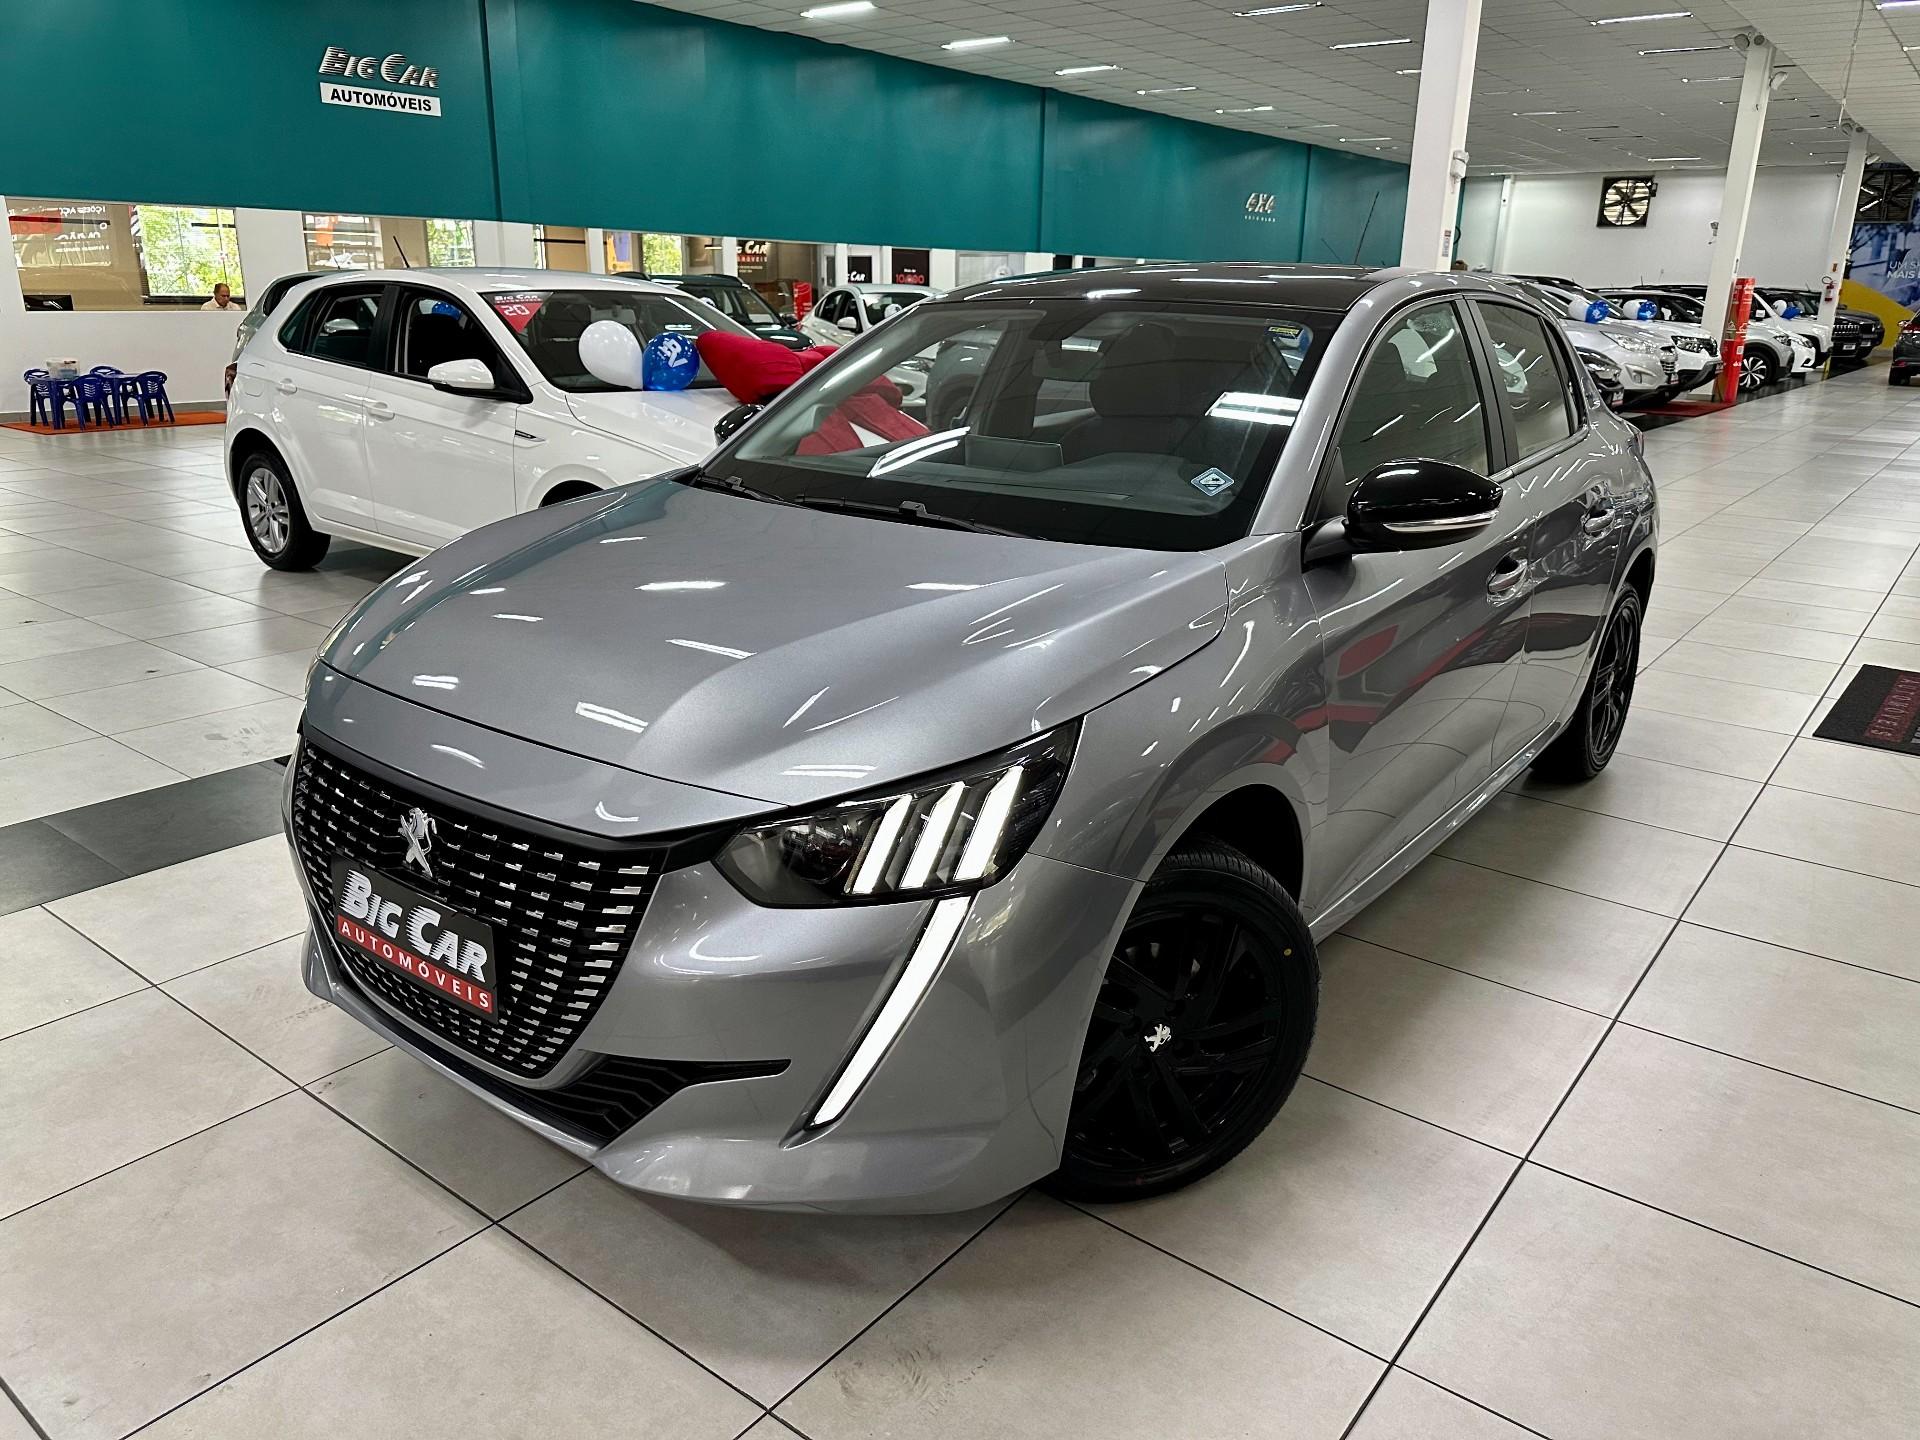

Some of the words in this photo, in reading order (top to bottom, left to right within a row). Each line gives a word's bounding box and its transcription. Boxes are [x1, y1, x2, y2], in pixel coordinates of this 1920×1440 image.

[319, 46, 380, 79] BIG
[381, 54, 439, 88] CAR
[330, 88, 432, 111] AUTOMÓVEIS
[501, 304, 530, 316] 20
[339, 869, 403, 939] BIG
[406, 905, 488, 983] CAR
[341, 921, 489, 1008] AUTOMÓVEIS
